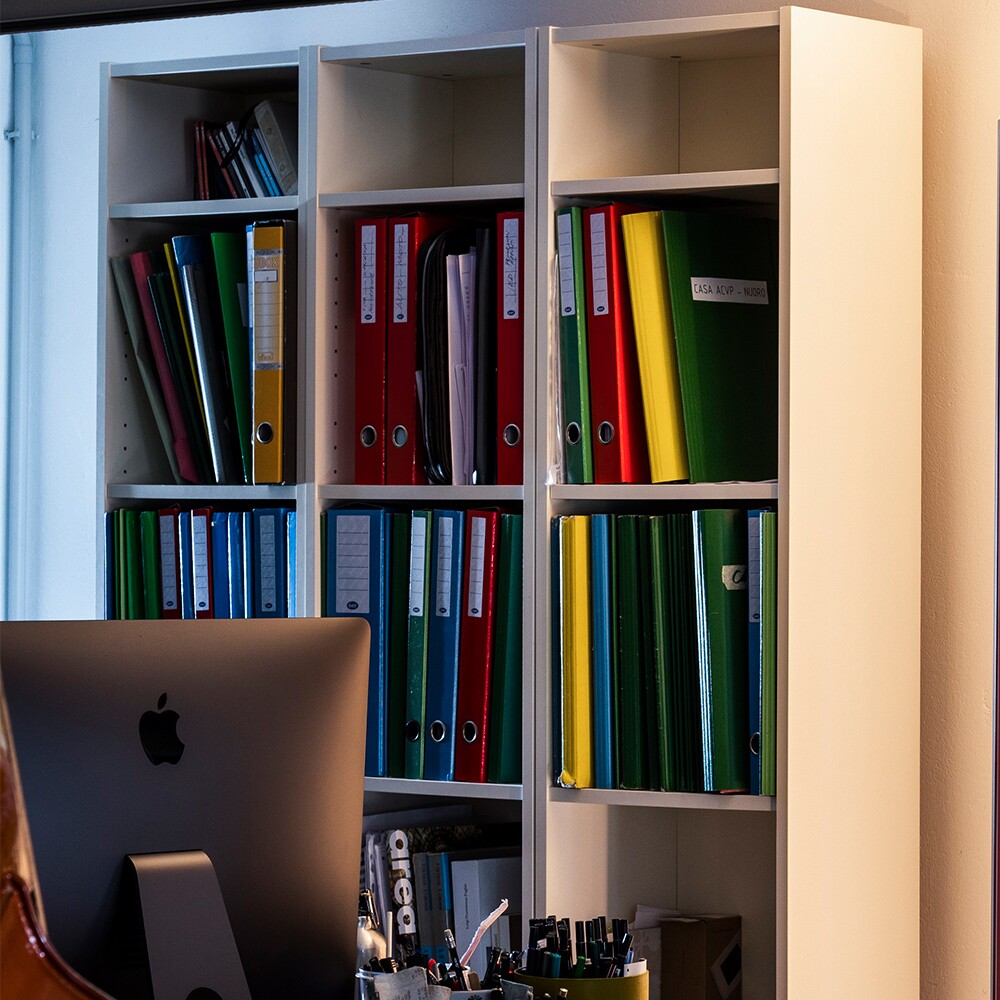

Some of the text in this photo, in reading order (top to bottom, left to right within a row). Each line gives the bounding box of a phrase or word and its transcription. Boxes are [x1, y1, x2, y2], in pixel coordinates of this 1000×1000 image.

[693, 283, 766, 298] CASA ACVP NUORO
[389, 829, 417, 935] area
